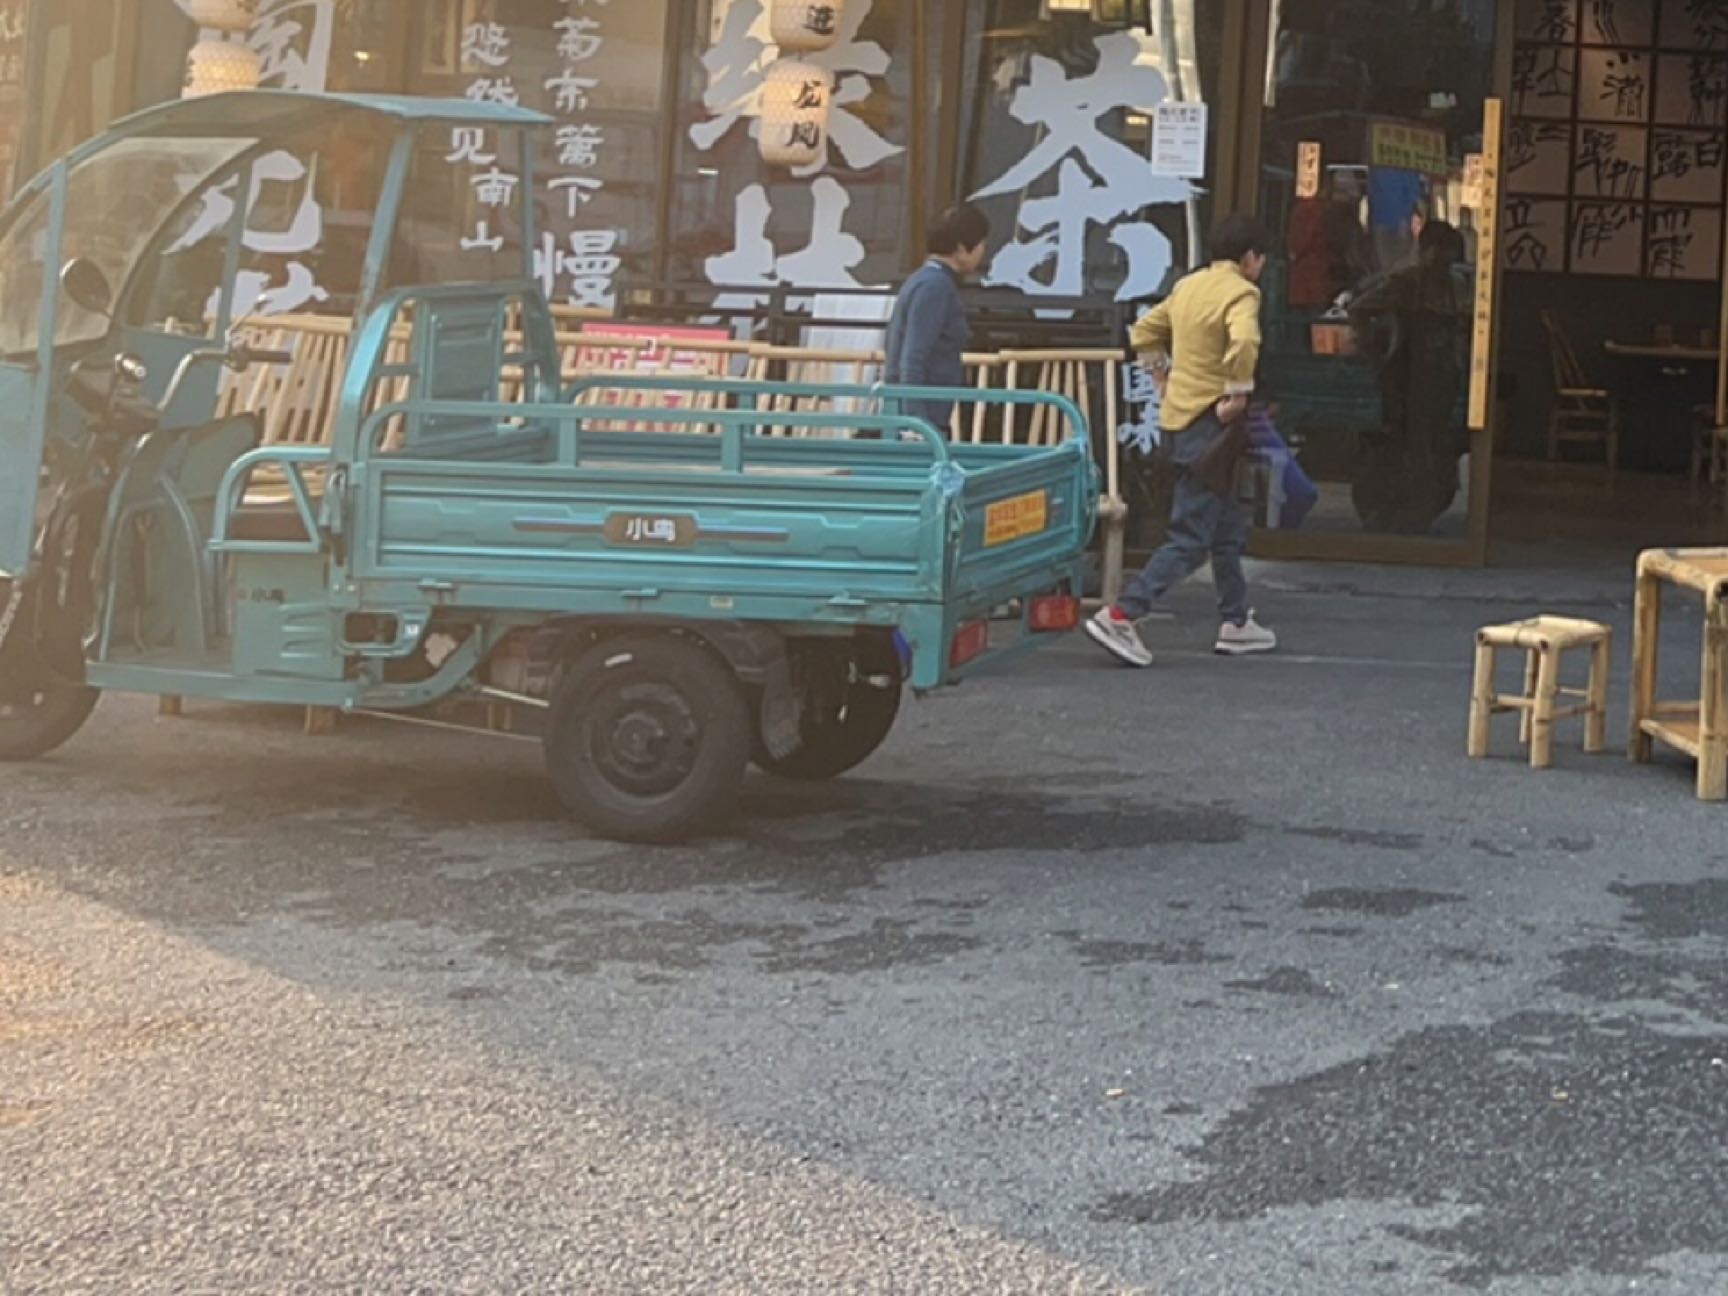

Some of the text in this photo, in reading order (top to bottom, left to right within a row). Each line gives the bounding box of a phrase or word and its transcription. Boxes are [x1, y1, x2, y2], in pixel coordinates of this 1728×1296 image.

[447, 22, 519, 252] 悠然见南山
[965, 31, 1208, 319] 茶
